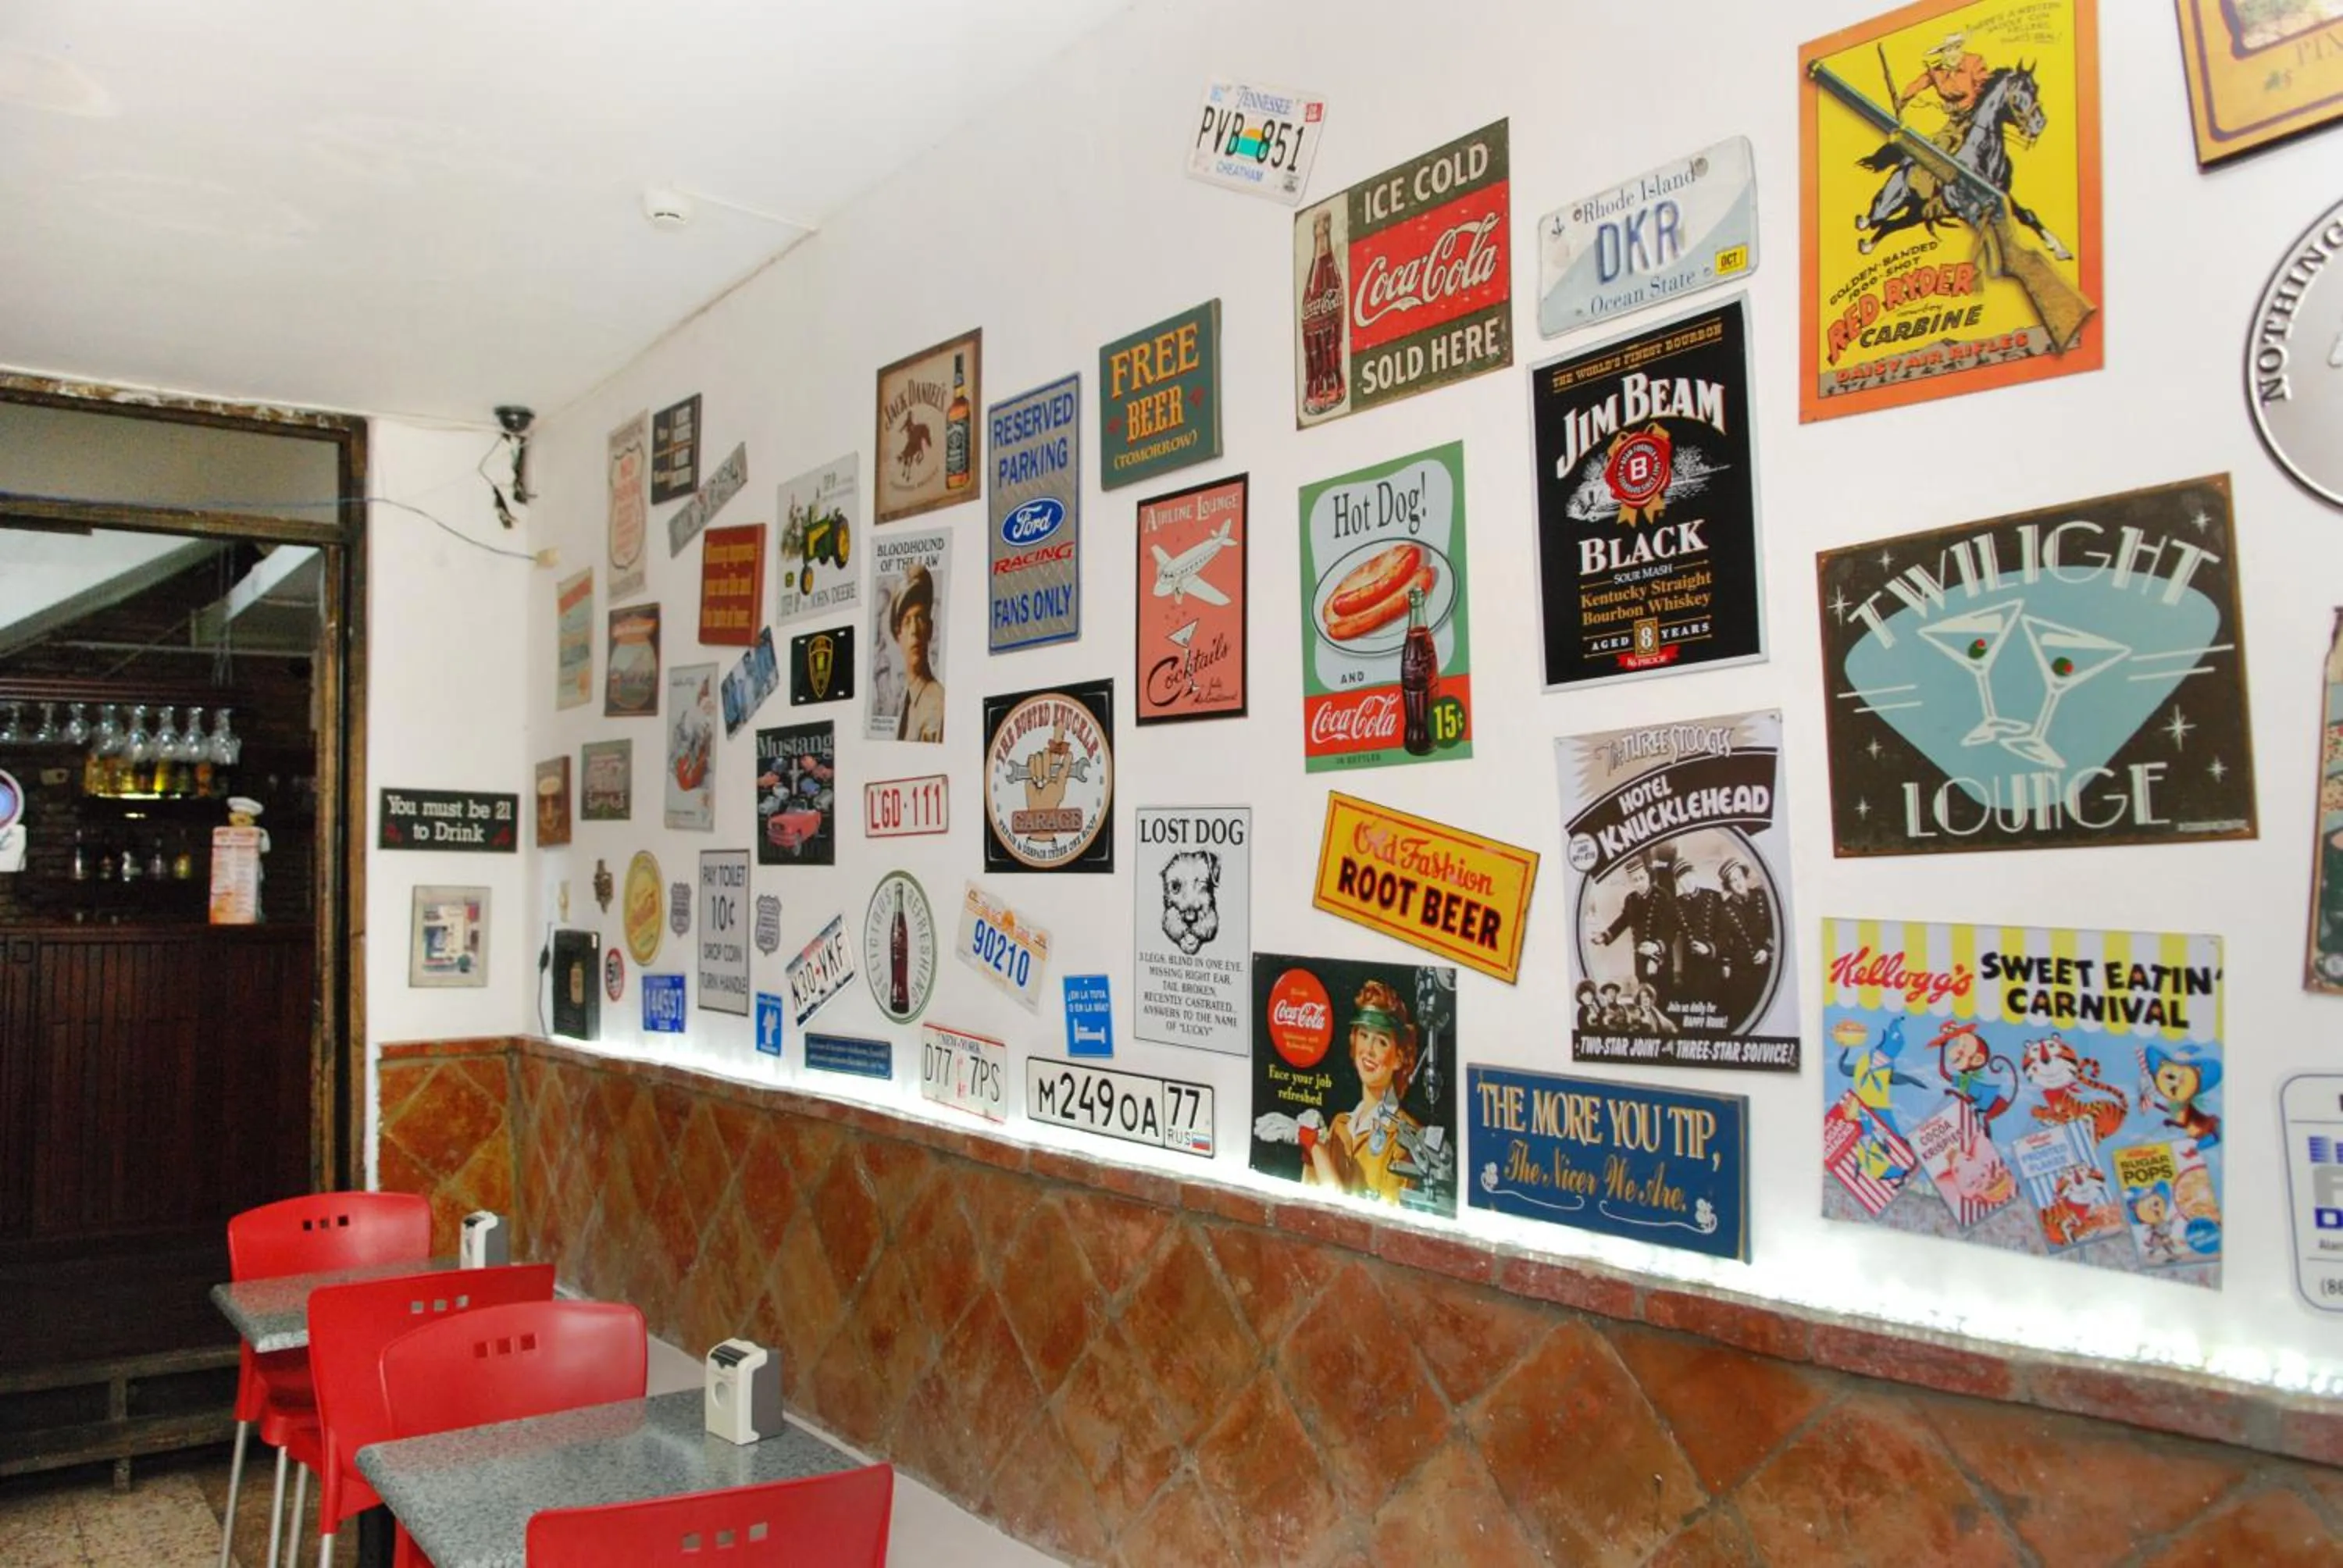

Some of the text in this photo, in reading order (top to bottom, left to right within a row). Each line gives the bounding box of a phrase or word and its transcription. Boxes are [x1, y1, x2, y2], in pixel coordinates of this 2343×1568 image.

[1196, 105, 1244, 156] PVB
[1256, 119, 1304, 172] 851
[1364, 142, 1489, 224] ICE COLD
[1582, 161, 1696, 224] Rhode Island
[1596, 199, 1679, 286] DKR
[1354, 212, 1500, 327] Coca-Cola
[1591, 271, 1696, 315] Ocean State
[1827, 262, 1976, 366] RED RYDER
[2256, 216, 2343, 408] NOTHING
[1860, 304, 1984, 349] CARBINE
[1110, 322, 1200, 399] FREE
[1361, 317, 1500, 394] SOLD HERE
[1553, 321, 1724, 388] THE WORLD'S FINEST BOURBON
[1836, 331, 2029, 383] DAISY AIR RIFLES
[885, 395, 908, 431] JACK
[994, 393, 1075, 450] RESERVED
[1126, 384, 1185, 444] BEER
[1557, 393, 1620, 479] JIM
[1621, 372, 1728, 437] BEAM
[998, 436, 1068, 489] PARKING
[1114, 429, 1199, 471] (TOMORROW)
[1630, 455, 1648, 482] B
[1012, 504, 1052, 539] Ford
[1145, 491, 1239, 533] AIRLINE LOUNGE
[1332, 470, 1427, 540] Hot Dog!
[877, 536, 945, 557] BLOODHOUND
[880, 558, 893, 572] OF
[993, 542, 1075, 576] RACING
[1578, 519, 1710, 576] BLACK
[1581, 571, 1713, 609] Kentucky Straight
[1614, 564, 1673, 585] SOUR MASH
[1846, 519, 2223, 650] TWILIGHT
[994, 583, 1072, 629] FANS ONLY
[1582, 592, 1711, 625] Bourbon Whiskey
[1591, 622, 1710, 650] AGED 8 YEARS
[1147, 630, 1231, 708] Cocktails
[1340, 670, 1366, 684] AND
[995, 703, 1100, 767] THE BUSTED KNUCKLE
[1311, 691, 1400, 746] Coca-Cola
[757, 733, 834, 761] Mustang
[1622, 725, 1735, 764] THREE STOOGES
[387, 794, 512, 821] You must be 21
[912, 783, 941, 826] 111
[1618, 774, 1673, 816] HOTEL
[1902, 761, 2172, 839] LOUNGE
[412, 821, 486, 843] to Drink
[1140, 818, 1245, 846] LOST DOG
[1598, 785, 1771, 861] KNUCKLEHEAD
[703, 865, 746, 888] PAY TOILET
[1353, 821, 1496, 897] Old Fashion
[711, 896, 735, 932] 10¢
[1337, 855, 1501, 951] ROOT BEER
[972, 919, 1030, 987] 90210
[1150, 966, 1211, 982] MISSING RIGHT
[1168, 955, 1223, 969] BLIND IN ONE
[1980, 952, 2224, 996] SWEET EATIN'
[1163, 980, 1178, 991] TAIL
[1830, 945, 1975, 1005] Kellogg's
[1144, 991, 1182, 1006] RECENTLY
[1144, 1005, 1237, 1028] ANSWERS TO THE NAME
[1274, 999, 1325, 1030] Coca-Cola
[2006, 989, 2190, 1030] CARNIVAL
[1166, 1021, 1176, 1030] OF
[969, 1055, 1000, 1102] 7PS
[1268, 1064, 1333, 1089] Face your job
[1277, 1086, 1323, 1107] refreshed
[1168, 1086, 1200, 1129] 77
[1477, 1082, 1721, 1172] THE MORE YOU TIP,
[1167, 1128, 1192, 1146] RUS
[1920, 1121, 1952, 1146] COCOA
[1504, 1139, 1541, 1185] The
[1542, 1147, 1600, 1196] Nicer
[1604, 1154, 1638, 1203] We
[2120, 1154, 2170, 1170] SUGAR
[2122, 1166, 2174, 1186] POPS
